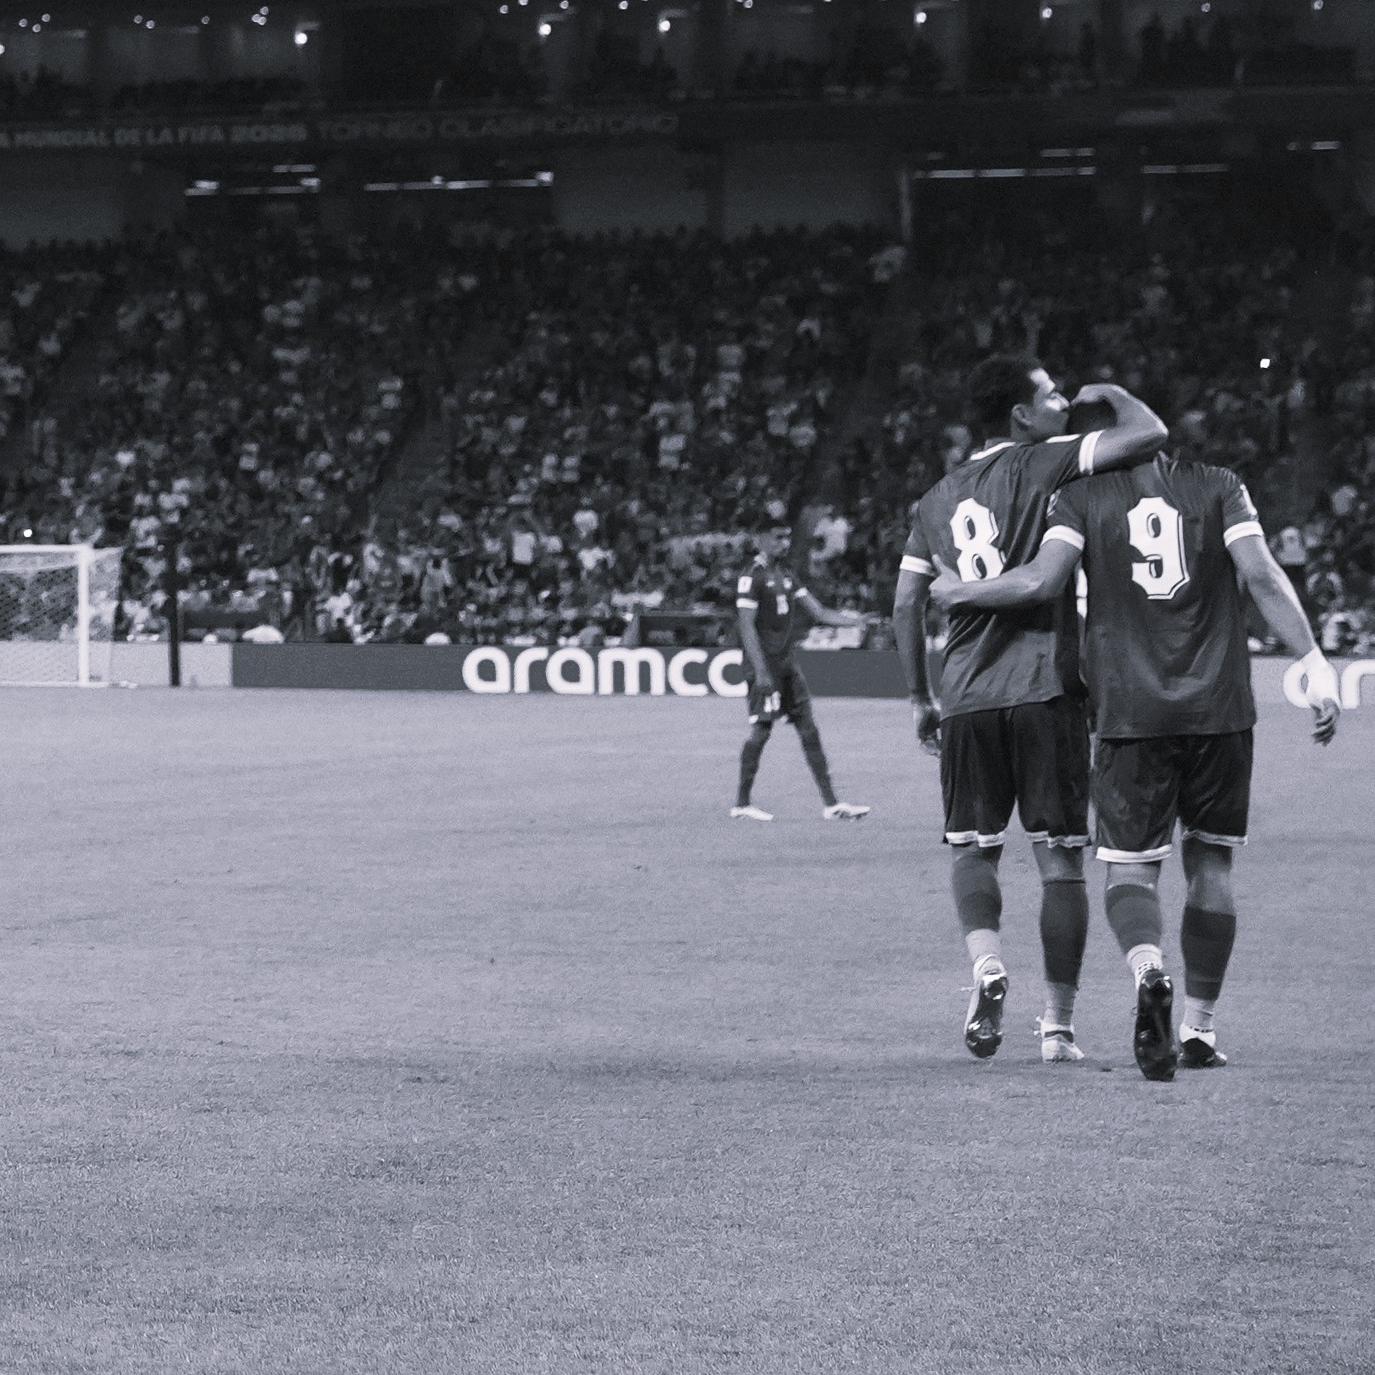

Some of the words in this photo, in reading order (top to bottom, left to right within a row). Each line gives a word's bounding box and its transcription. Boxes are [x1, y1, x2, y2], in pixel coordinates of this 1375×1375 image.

[14, 130, 110, 147] MUNDIAL
[114, 128, 141, 146] DE
[145, 127, 173, 145] LA
[177, 125, 224, 143] FIFA
[949, 498, 1006, 583] 8
[1126, 496, 1190, 600] 9
